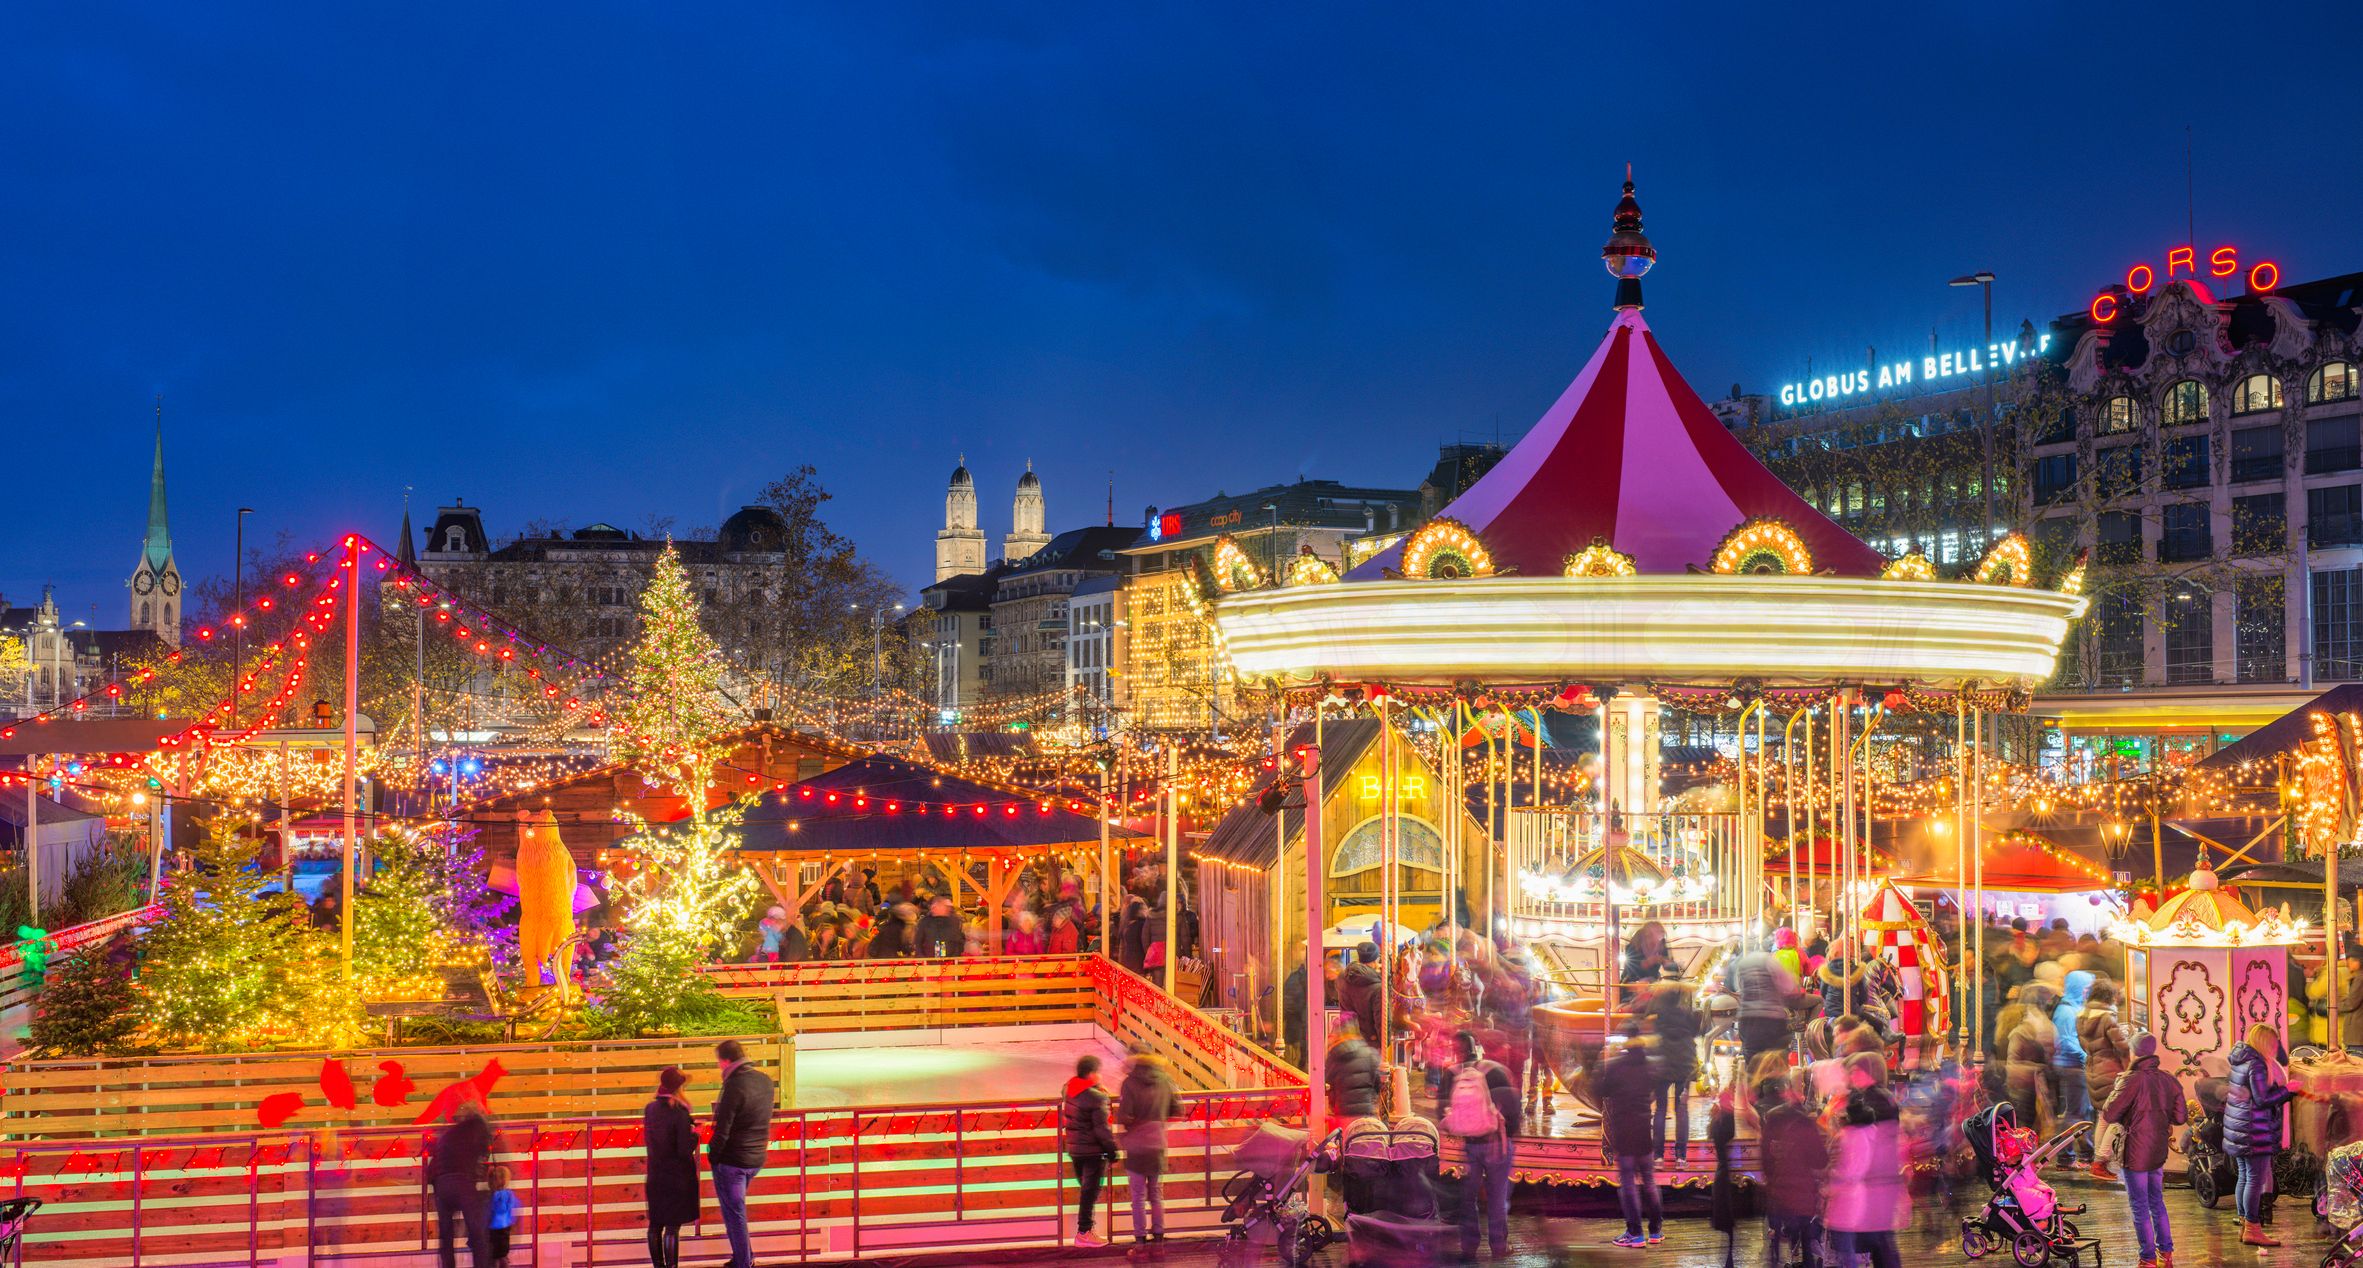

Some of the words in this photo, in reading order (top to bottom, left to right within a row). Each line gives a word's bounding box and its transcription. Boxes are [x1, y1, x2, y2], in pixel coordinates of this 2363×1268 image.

[2092, 246, 2279, 322] CORSO
[1781, 370, 1869, 406] GLOBUS
[1878, 361, 1912, 389] AM
[1924, 333, 2051, 380] BELLEVE
[1161, 513, 1181, 537] UBS
[1228, 509, 1243, 524] city
